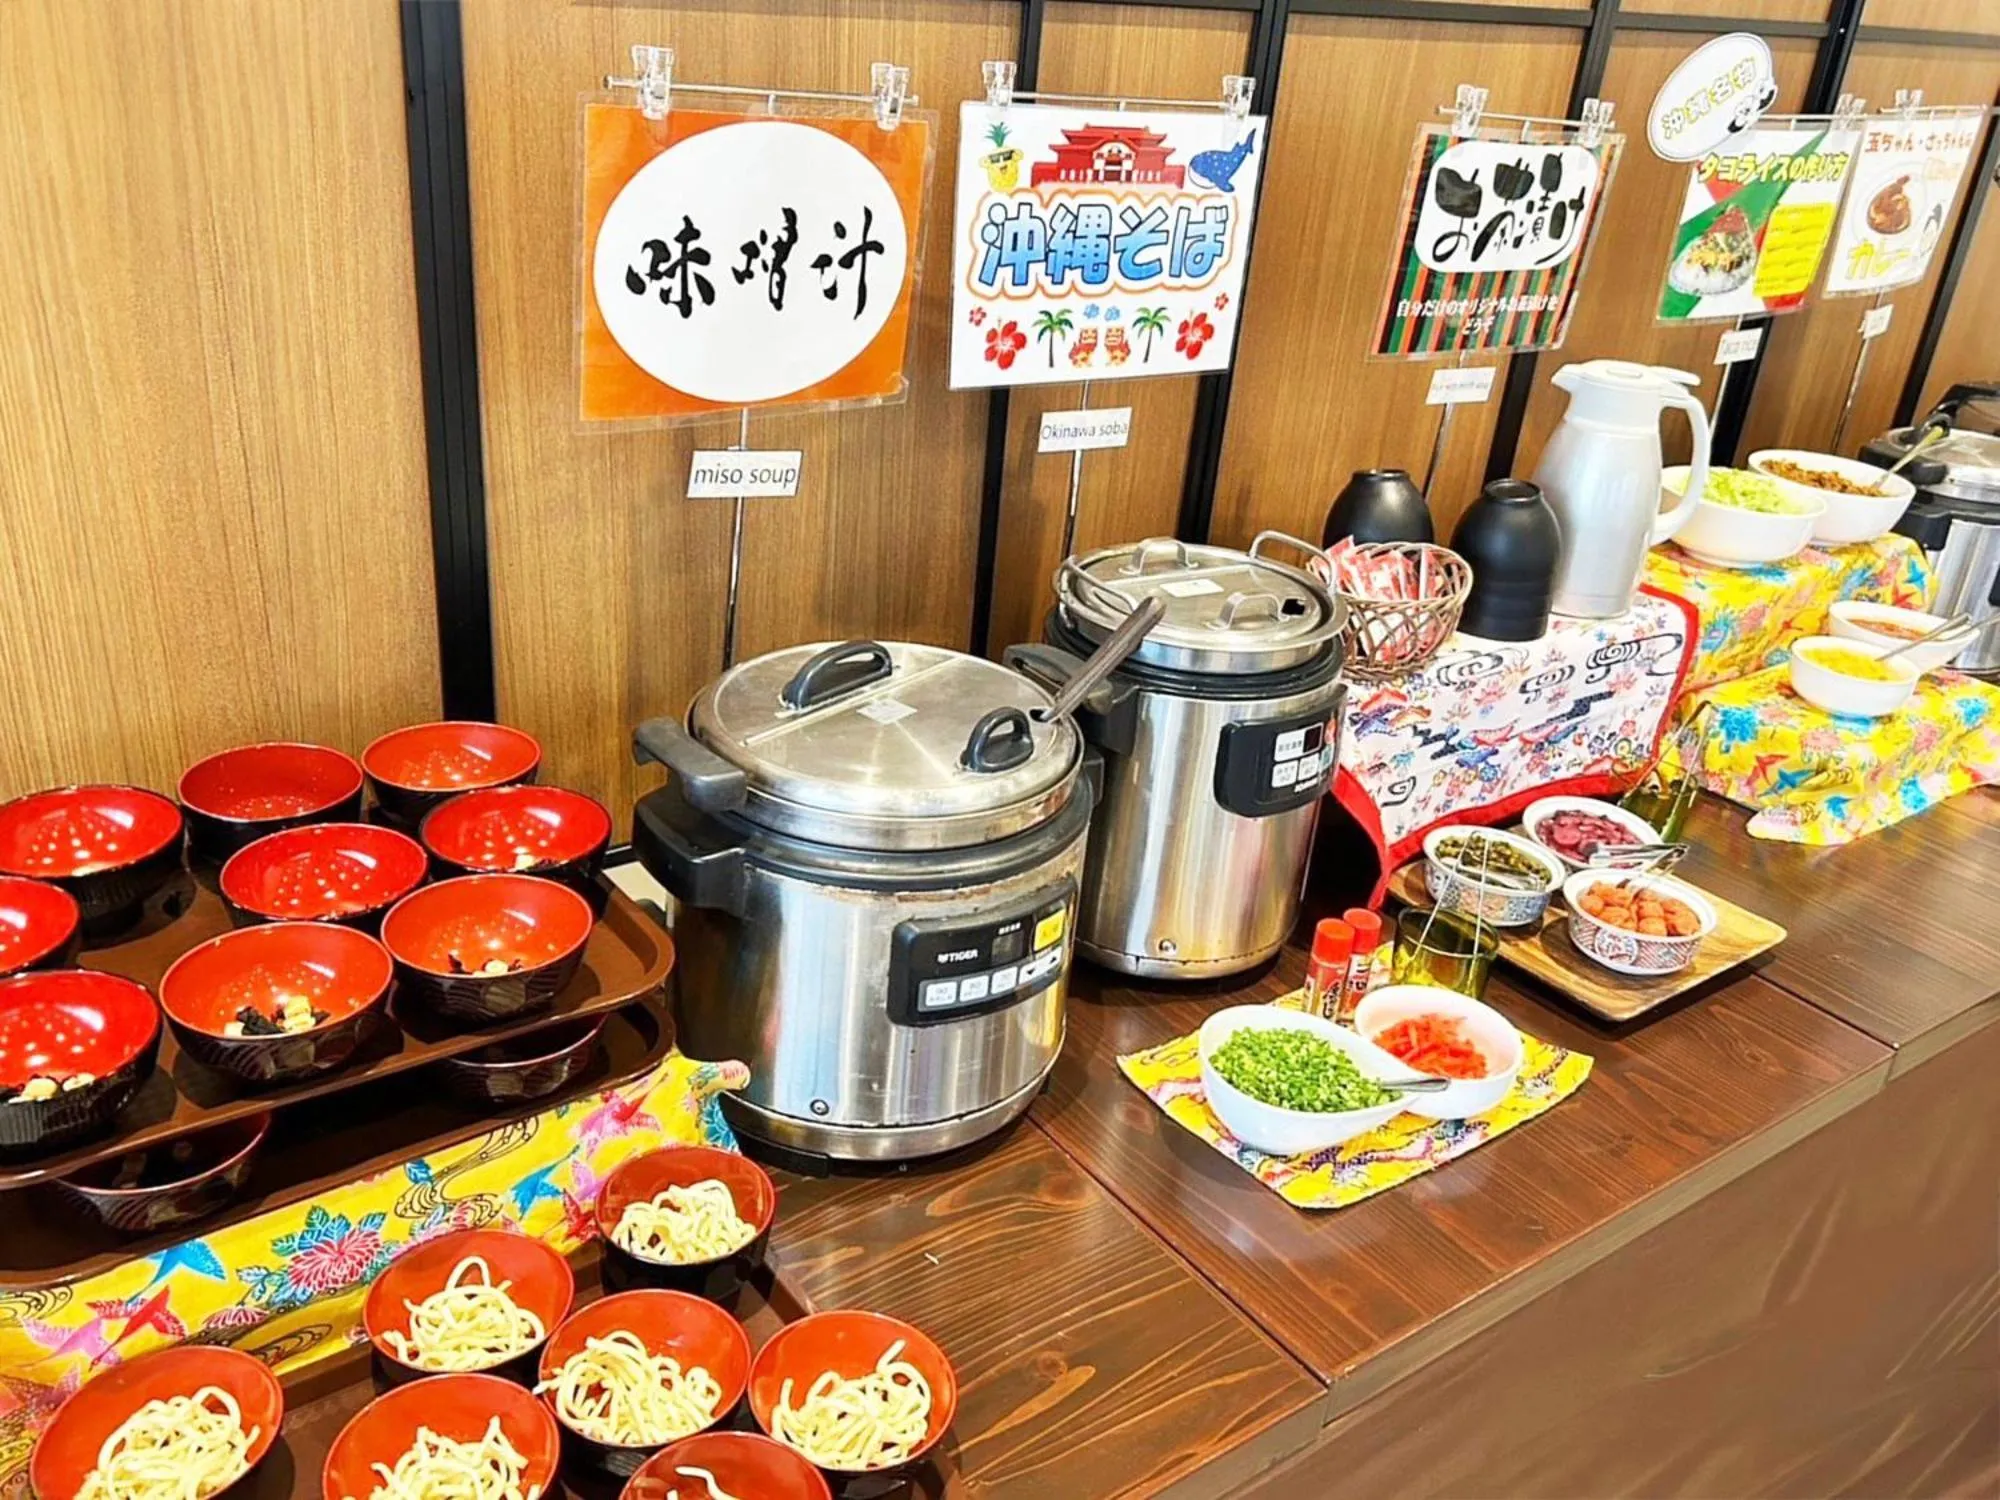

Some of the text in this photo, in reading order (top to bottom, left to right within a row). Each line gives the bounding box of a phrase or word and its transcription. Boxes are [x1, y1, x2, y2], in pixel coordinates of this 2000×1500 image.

[1697, 151, 1850, 184] タコライスの作り方
[978, 202, 1229, 287] 沖縄そば
[626, 206, 885, 320] 味噌汁
[1042, 420, 1128, 440] Okinawa soba
[694, 462, 796, 489] miso soup
[950, 949, 978, 962] TIGER
